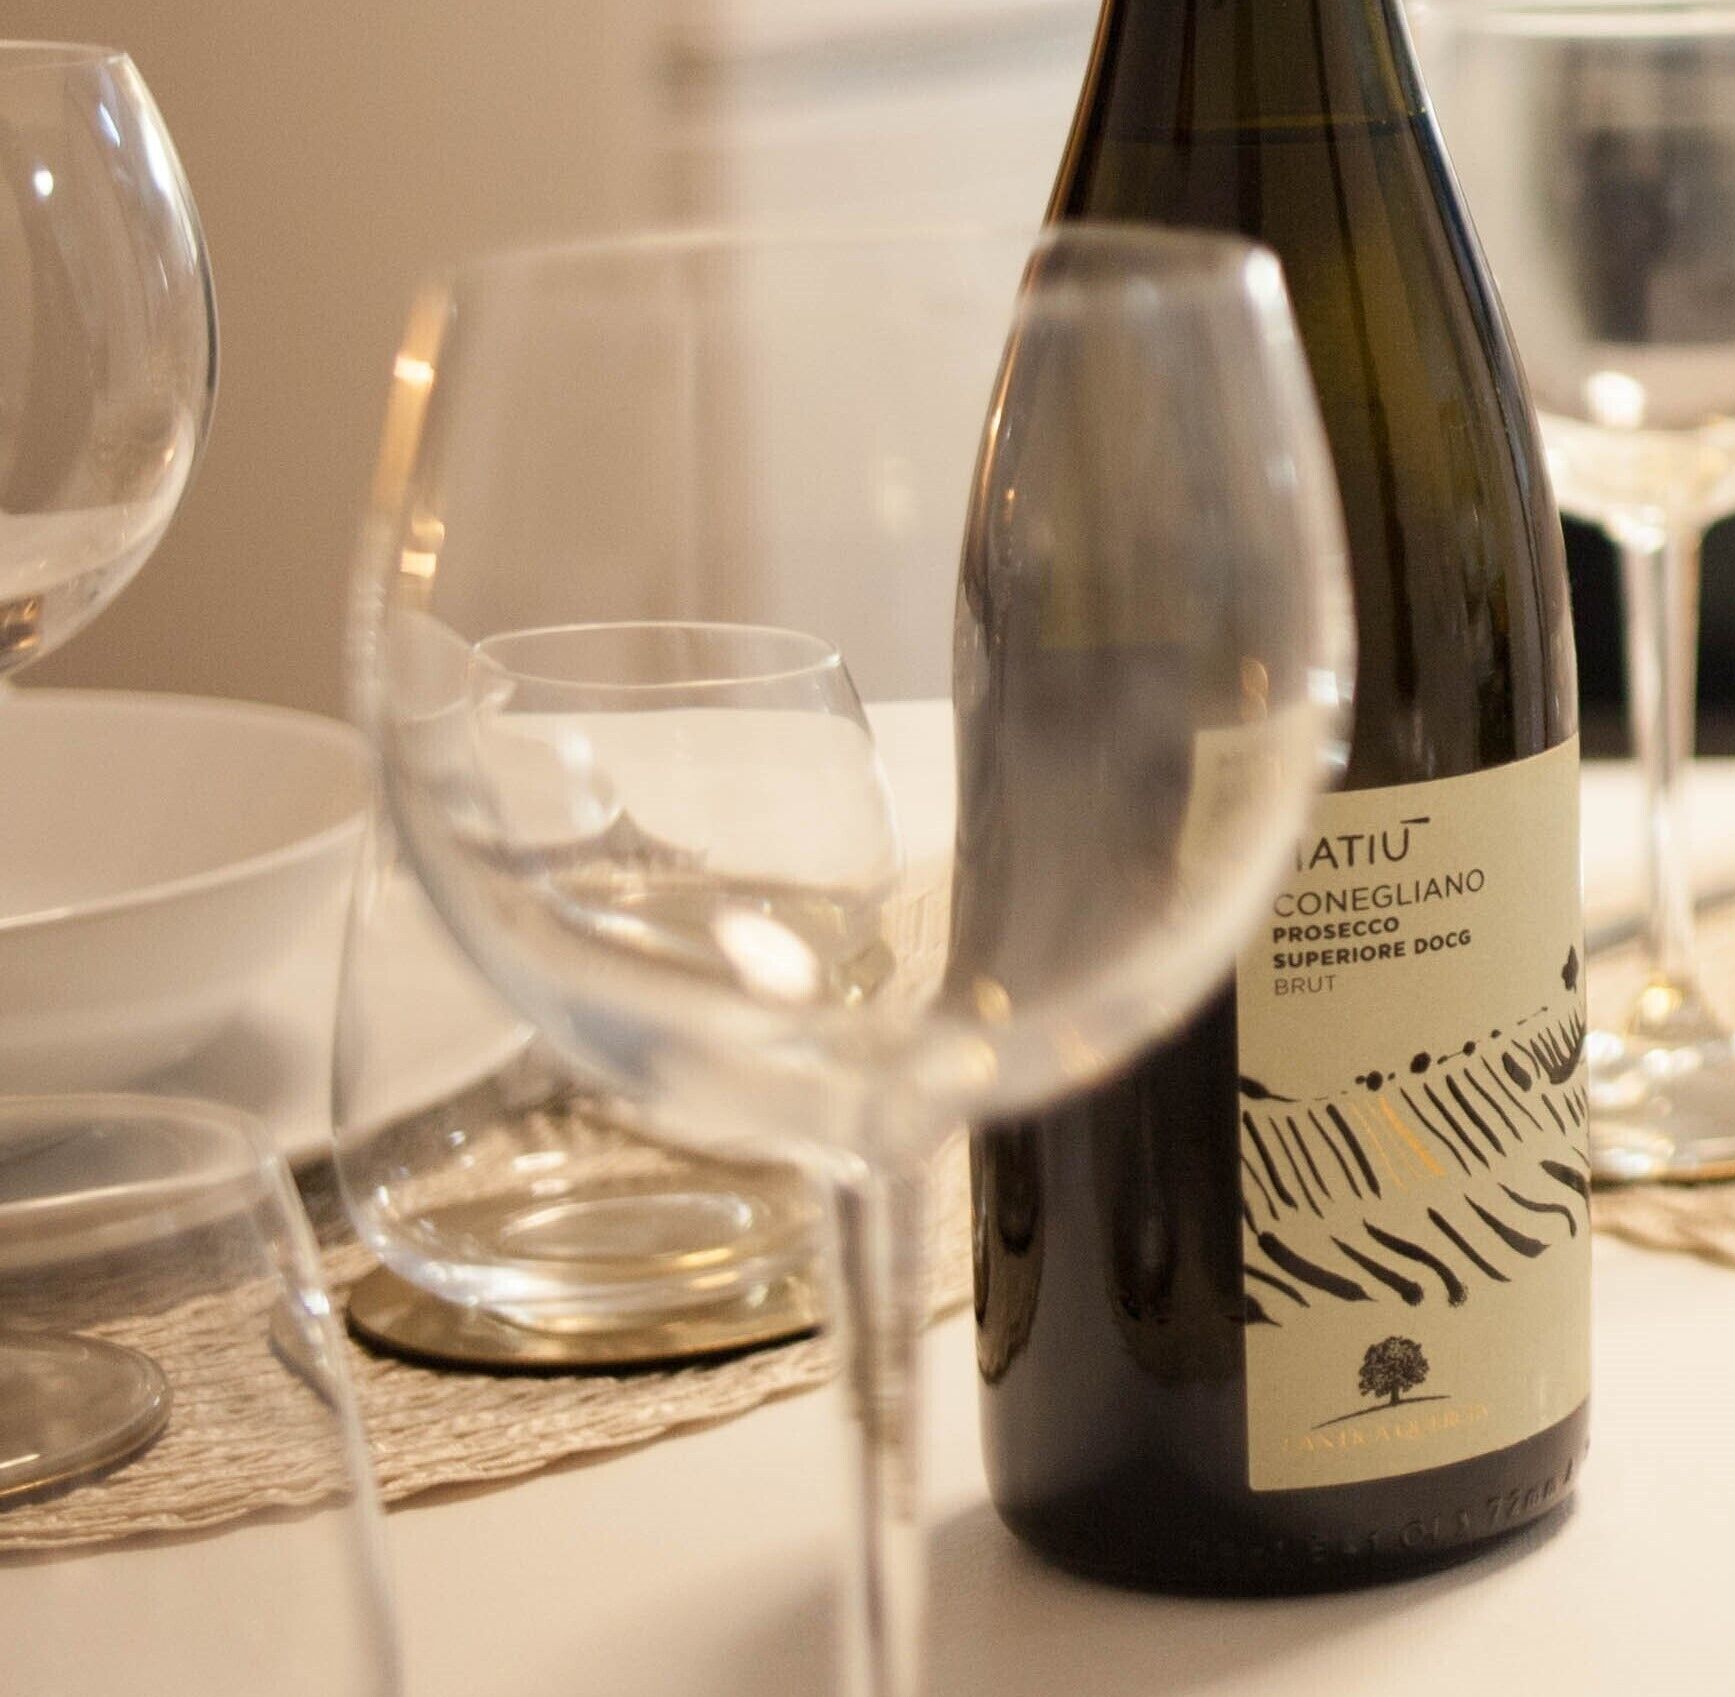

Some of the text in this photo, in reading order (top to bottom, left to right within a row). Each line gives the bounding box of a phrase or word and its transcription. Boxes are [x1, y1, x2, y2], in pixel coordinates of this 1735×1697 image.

[1272, 867, 1486, 918] CONEGLIANO
[1272, 916, 1400, 944] PROSECCO
[1273, 929, 1472, 970] SUPERIORE DOCG
[1273, 974, 1337, 997] BRUT
